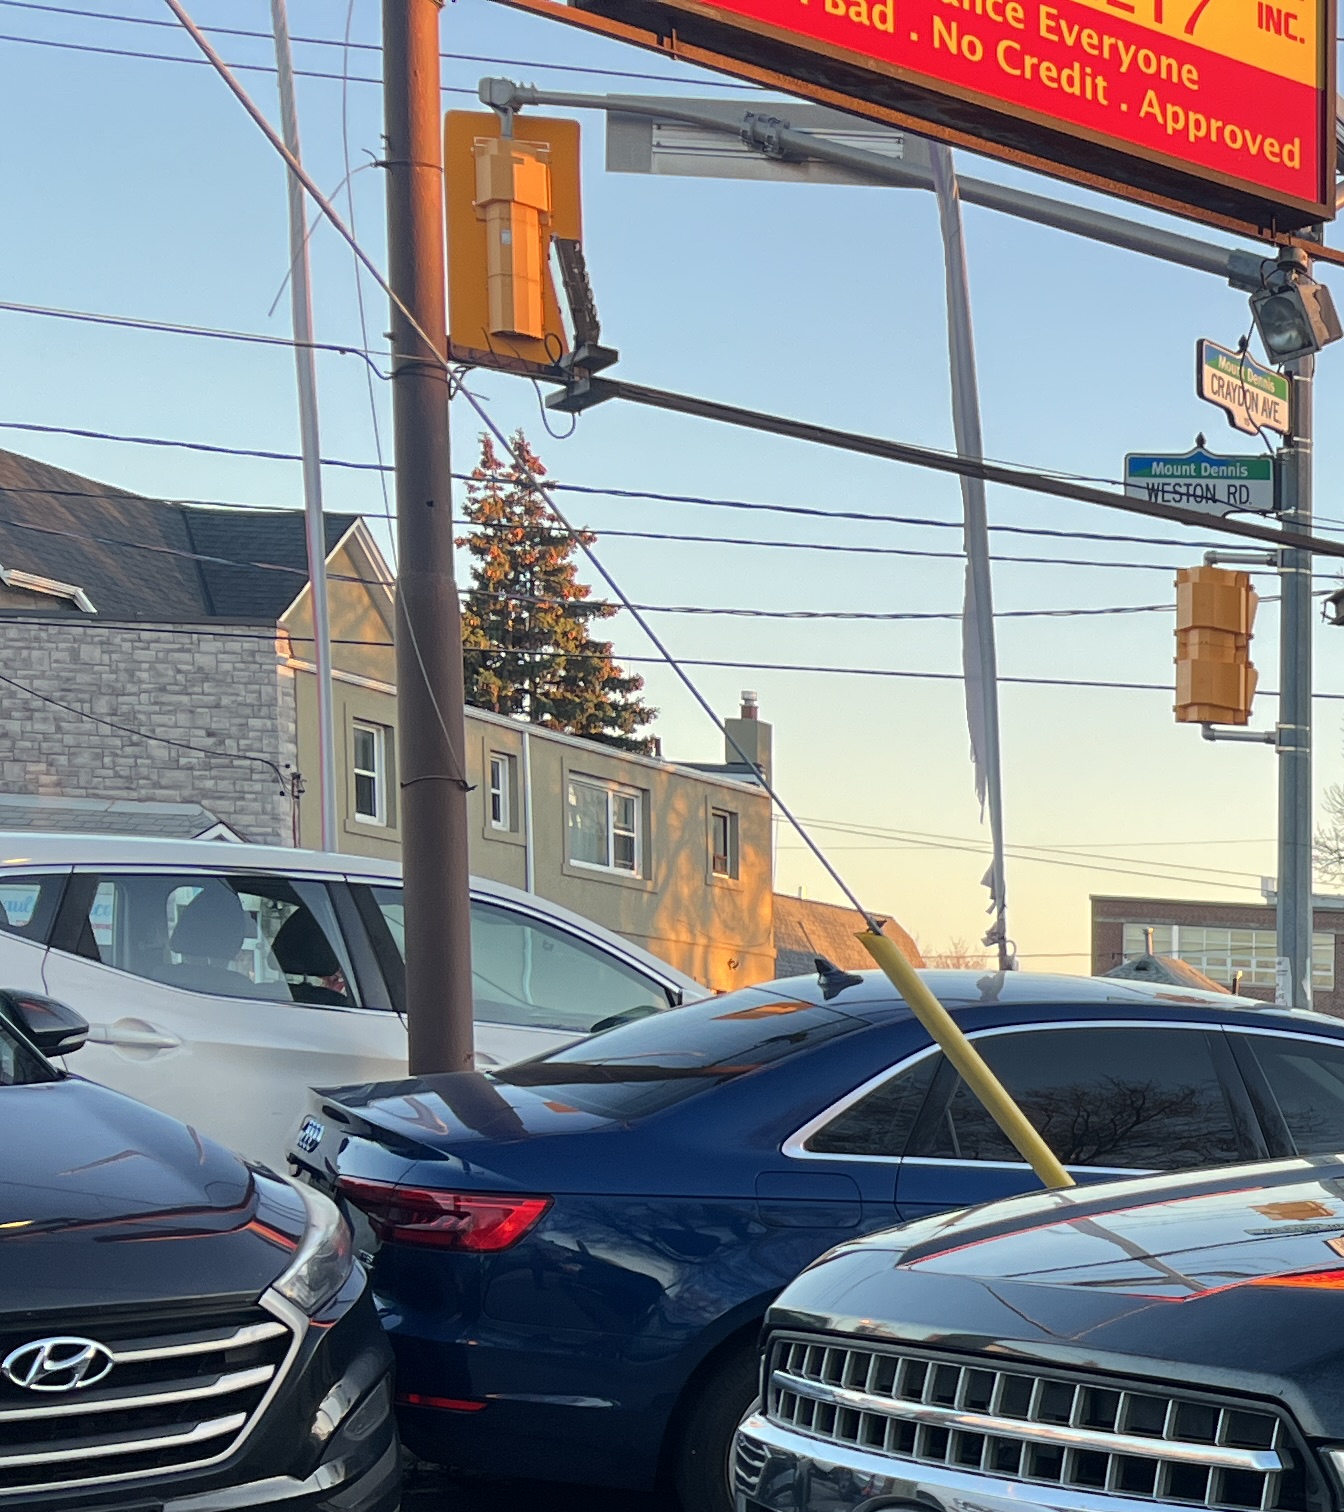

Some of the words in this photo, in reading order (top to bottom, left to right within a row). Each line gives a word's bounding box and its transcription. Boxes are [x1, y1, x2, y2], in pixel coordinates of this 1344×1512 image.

[1257, 1, 1305, 44] INC.
[1039, 4, 1200, 90] Everyone
[932, 15, 983, 62] No
[996, 39, 1109, 106] Credit
[1139, 89, 1301, 170] Approved
[1210, 373, 1260, 415] CRAYDON
[1218, 354, 1246, 379] Mount
[1247, 367, 1276, 393] Dennis
[1151, 461, 1197, 476] Mount
[1201, 462, 1249, 478] Dennis
[1146, 482, 1218, 505] WESTON
[1227, 484, 1253, 505] RD.
